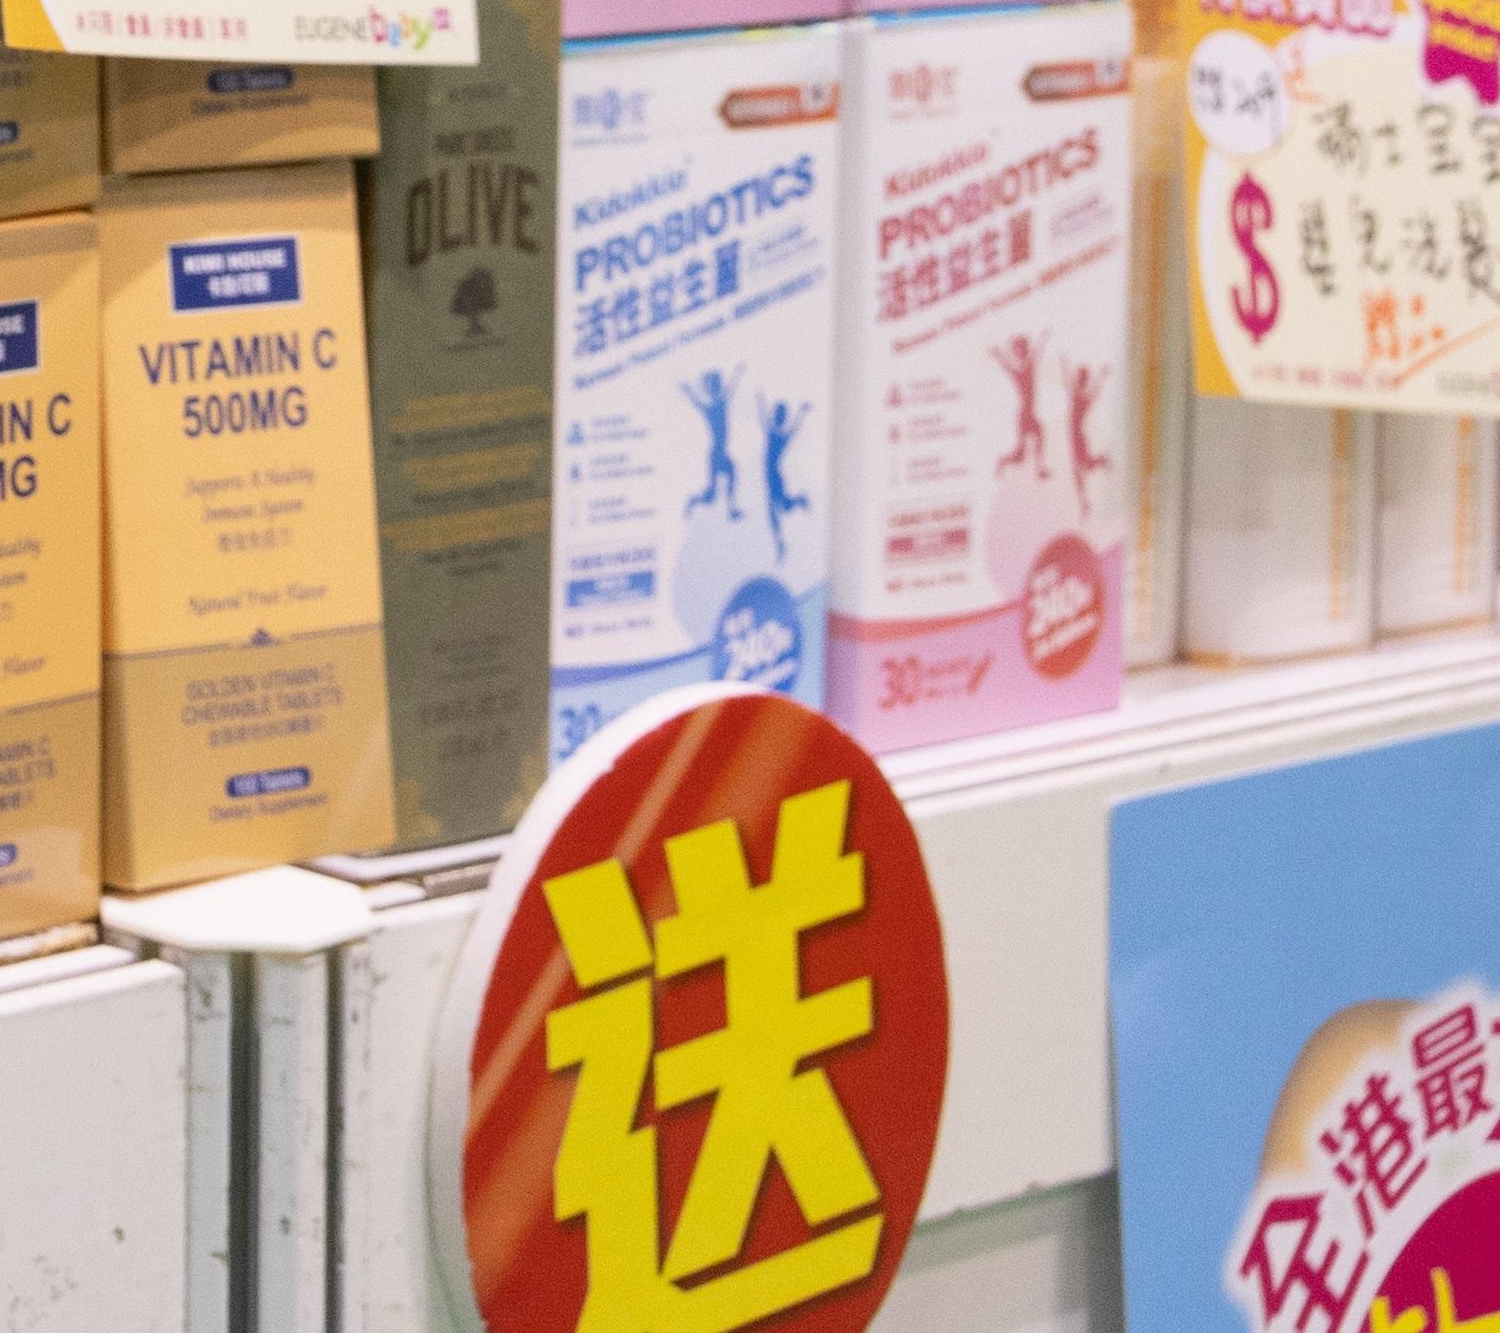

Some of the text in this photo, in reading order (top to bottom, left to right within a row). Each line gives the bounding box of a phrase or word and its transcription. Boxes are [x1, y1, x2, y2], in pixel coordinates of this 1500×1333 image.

[574, 154, 814, 292] PROBIOTICS
[878, 129, 1099, 261] PROBIOTICS
[46, 393, 73, 437] C
[138, 328, 337, 386] VITAMIN C
[182, 386, 308, 439] 500MG
[541, 778, 885, 1333] 送
[1238, 1002, 1500, 1333] 全港最
